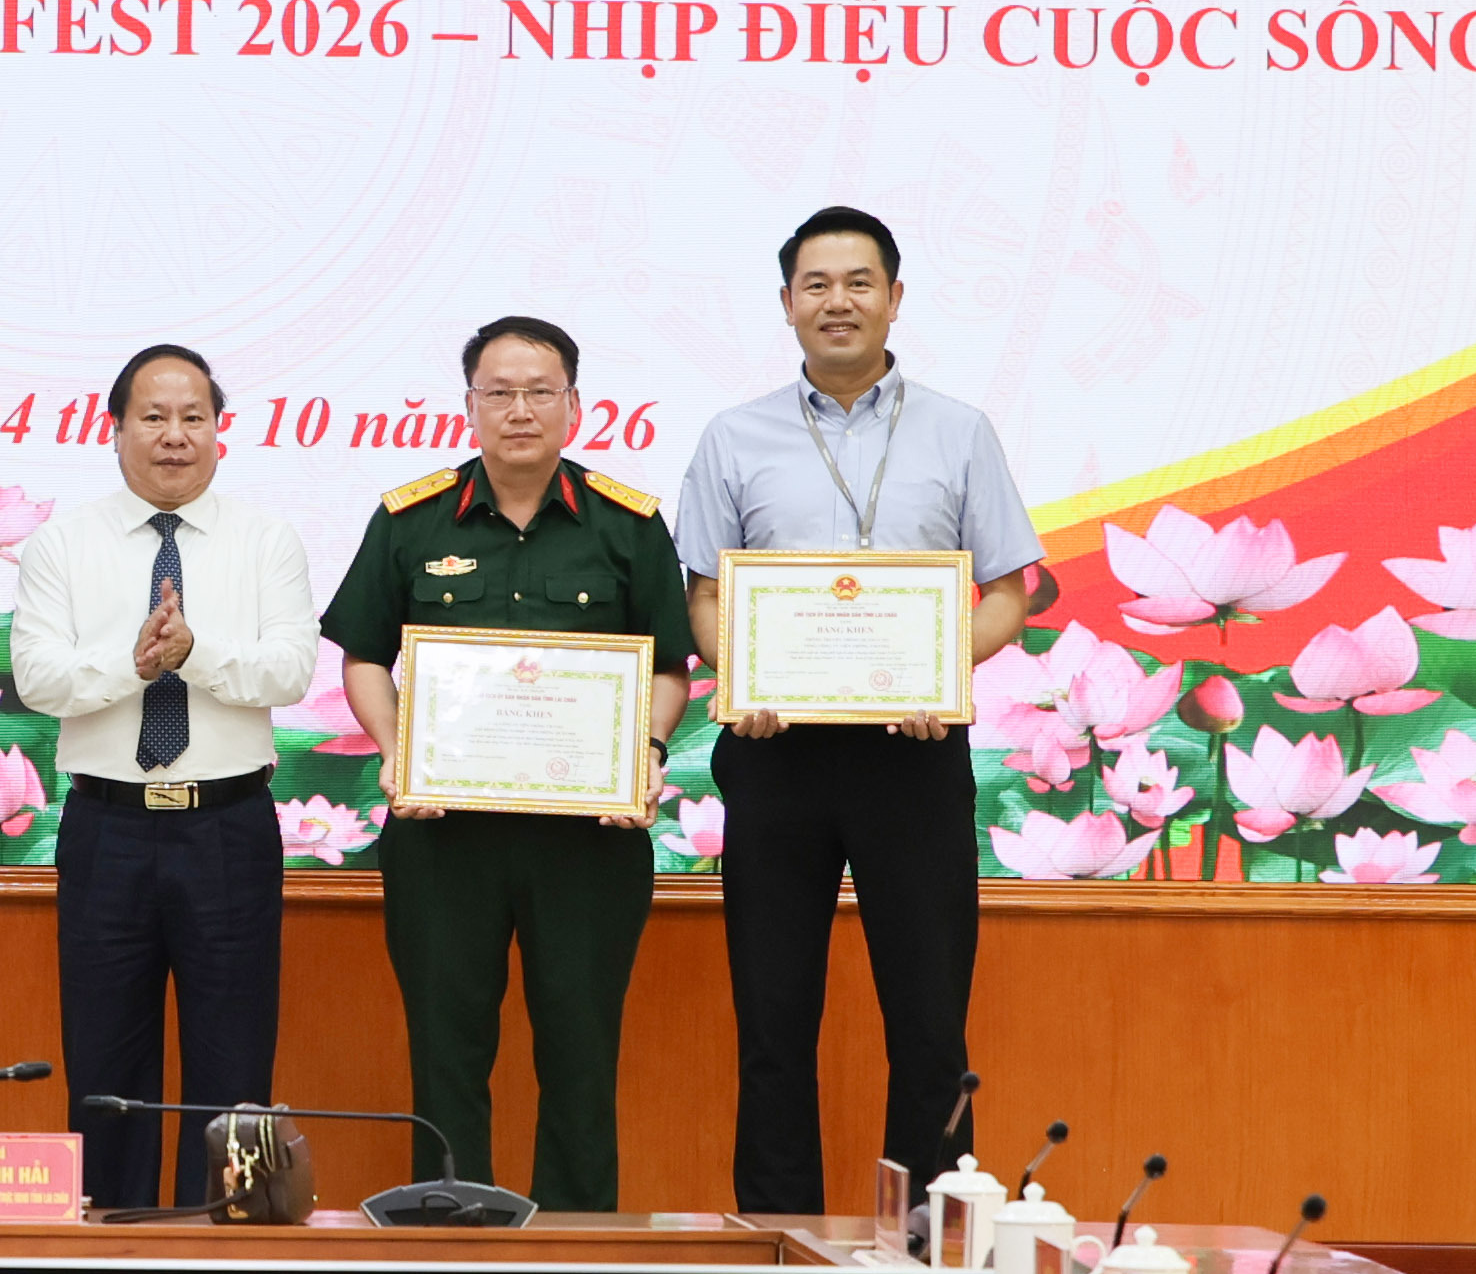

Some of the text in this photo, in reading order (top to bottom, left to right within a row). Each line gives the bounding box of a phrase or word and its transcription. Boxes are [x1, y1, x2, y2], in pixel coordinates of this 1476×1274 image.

[502, 0, 719, 80] NHỊP
[56, 392, 237, 461] thg
[262, 396, 332, 449] 10
[559, 398, 660, 452] 26
[18, 1159, 50, 1185] HẢI
